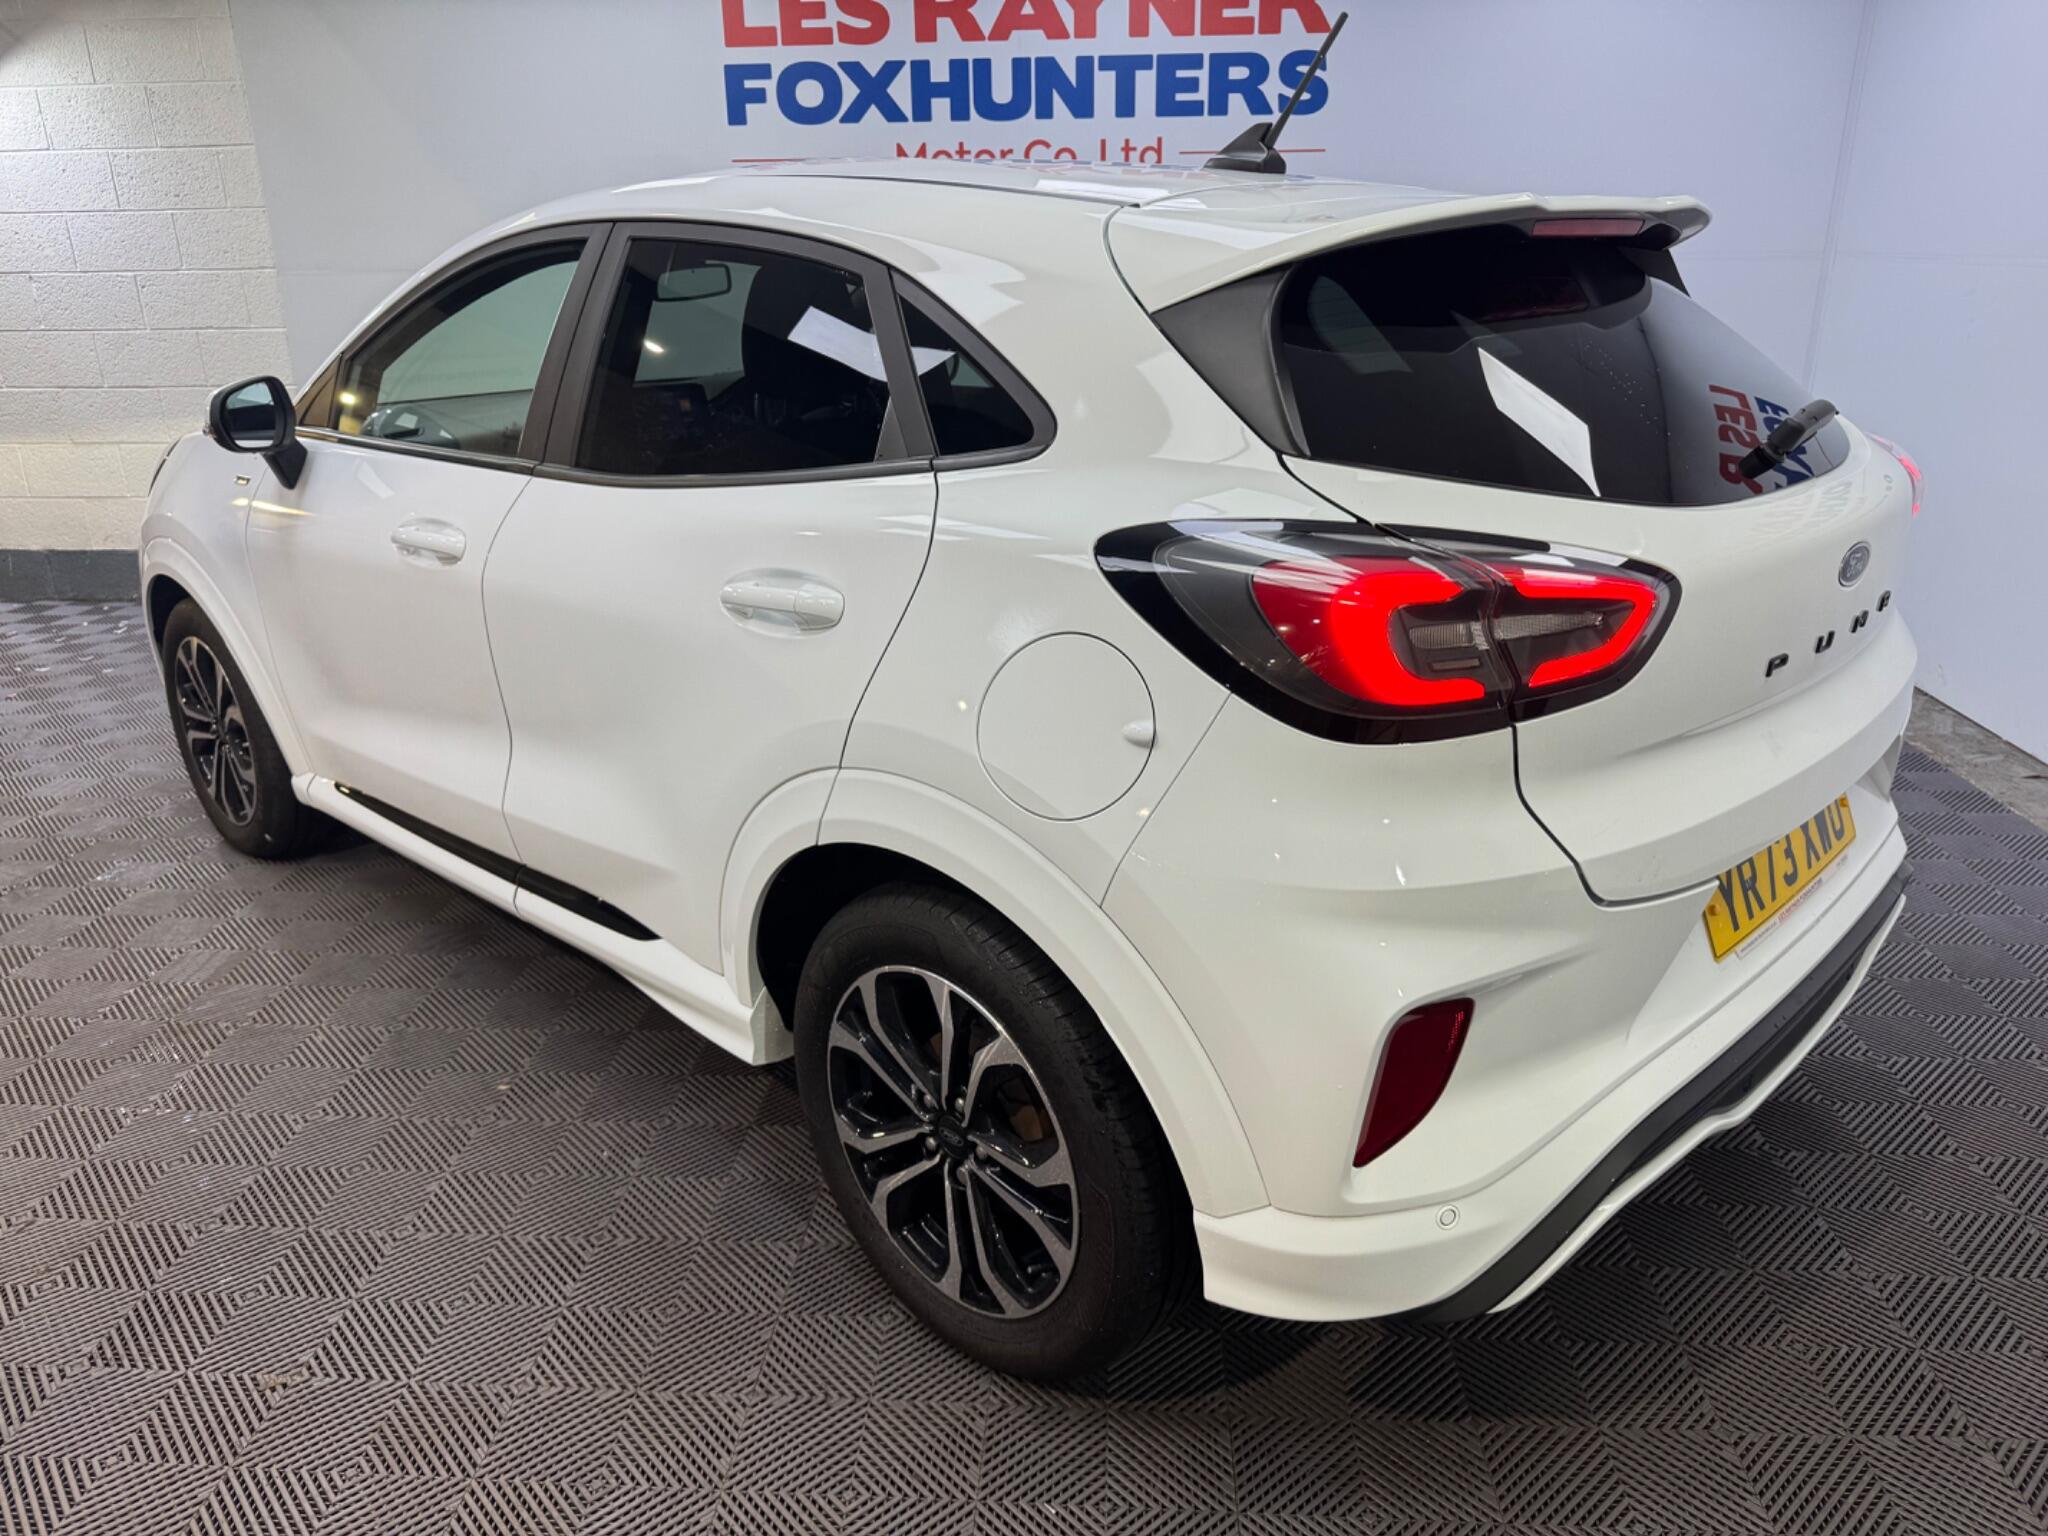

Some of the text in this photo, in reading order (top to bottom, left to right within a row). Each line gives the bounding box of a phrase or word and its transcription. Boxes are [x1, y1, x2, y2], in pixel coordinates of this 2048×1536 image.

[722, 0, 1332, 48] LES RAYNER
[723, 50, 1330, 126] FOXHUNTERS
[1716, 833, 1799, 933] YR73
